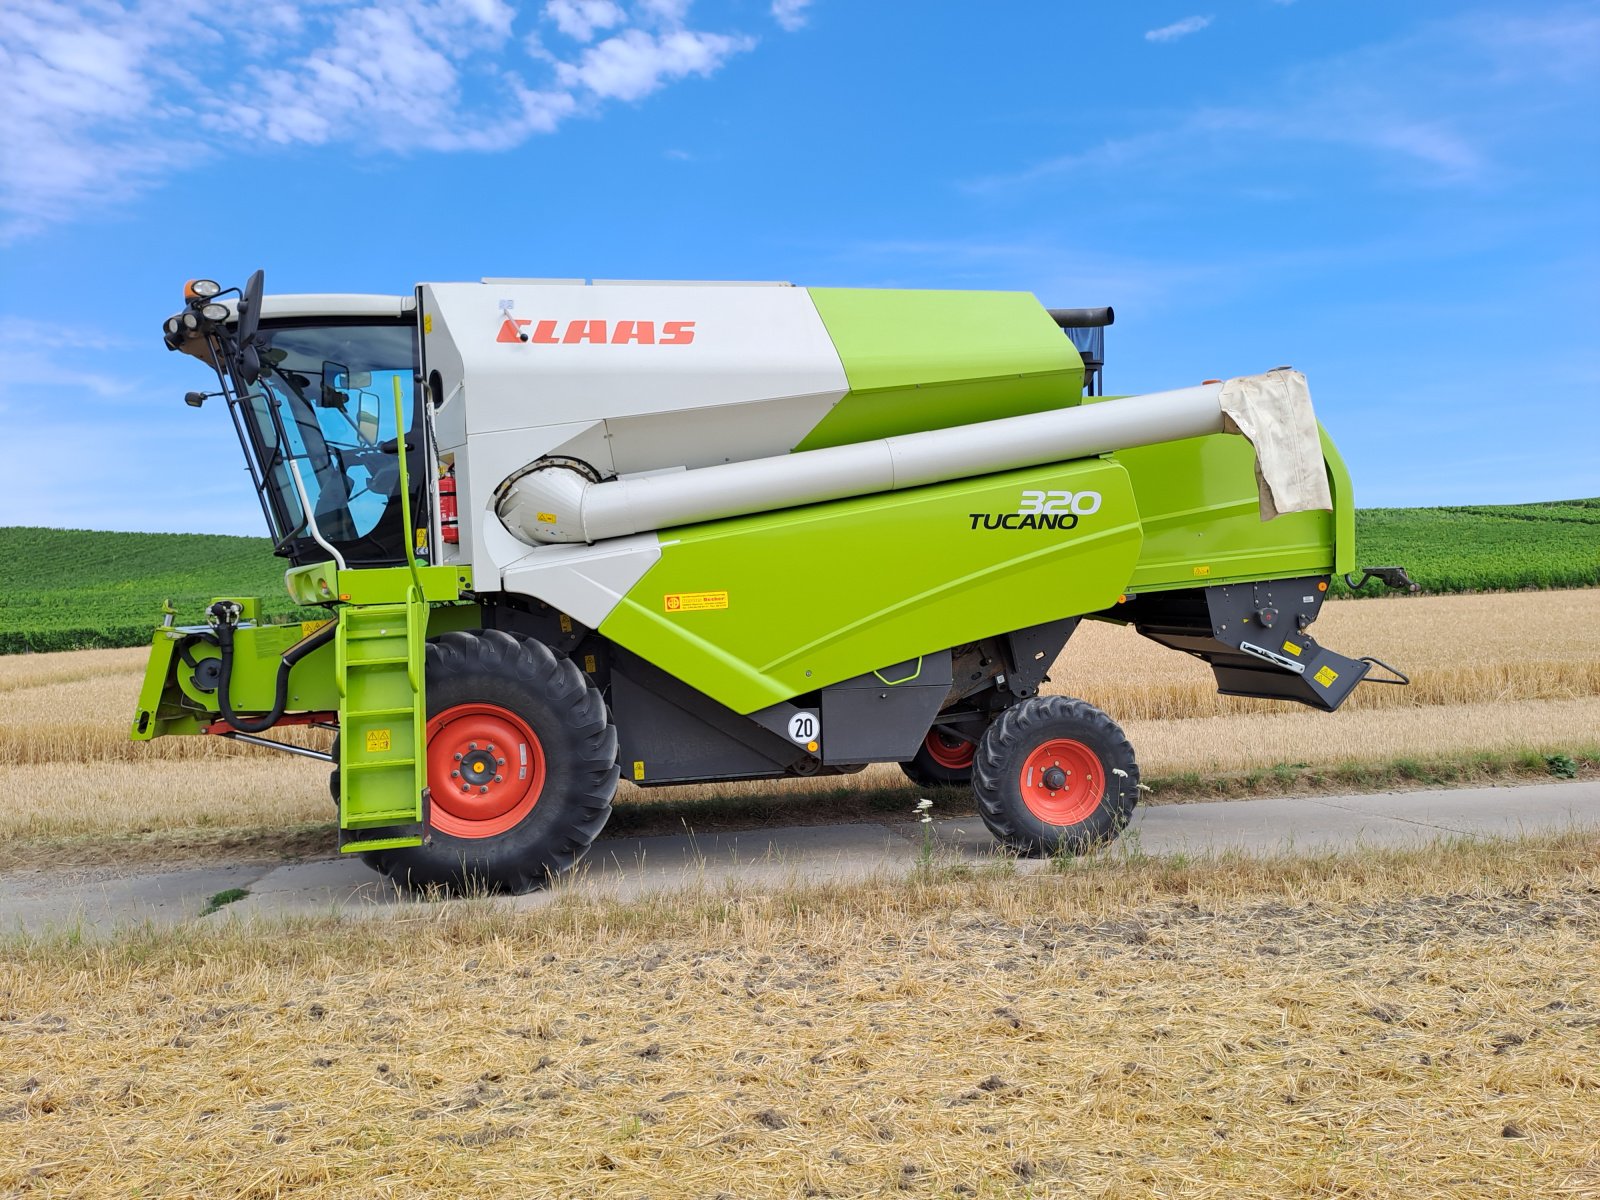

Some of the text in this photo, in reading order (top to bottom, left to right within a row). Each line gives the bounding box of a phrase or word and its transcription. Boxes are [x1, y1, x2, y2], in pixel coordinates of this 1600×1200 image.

[496, 320, 696, 344] CLAAS
[1017, 490, 1102, 515] 320
[969, 513, 1079, 529] TUCANO
[795, 718, 813, 737] 20
